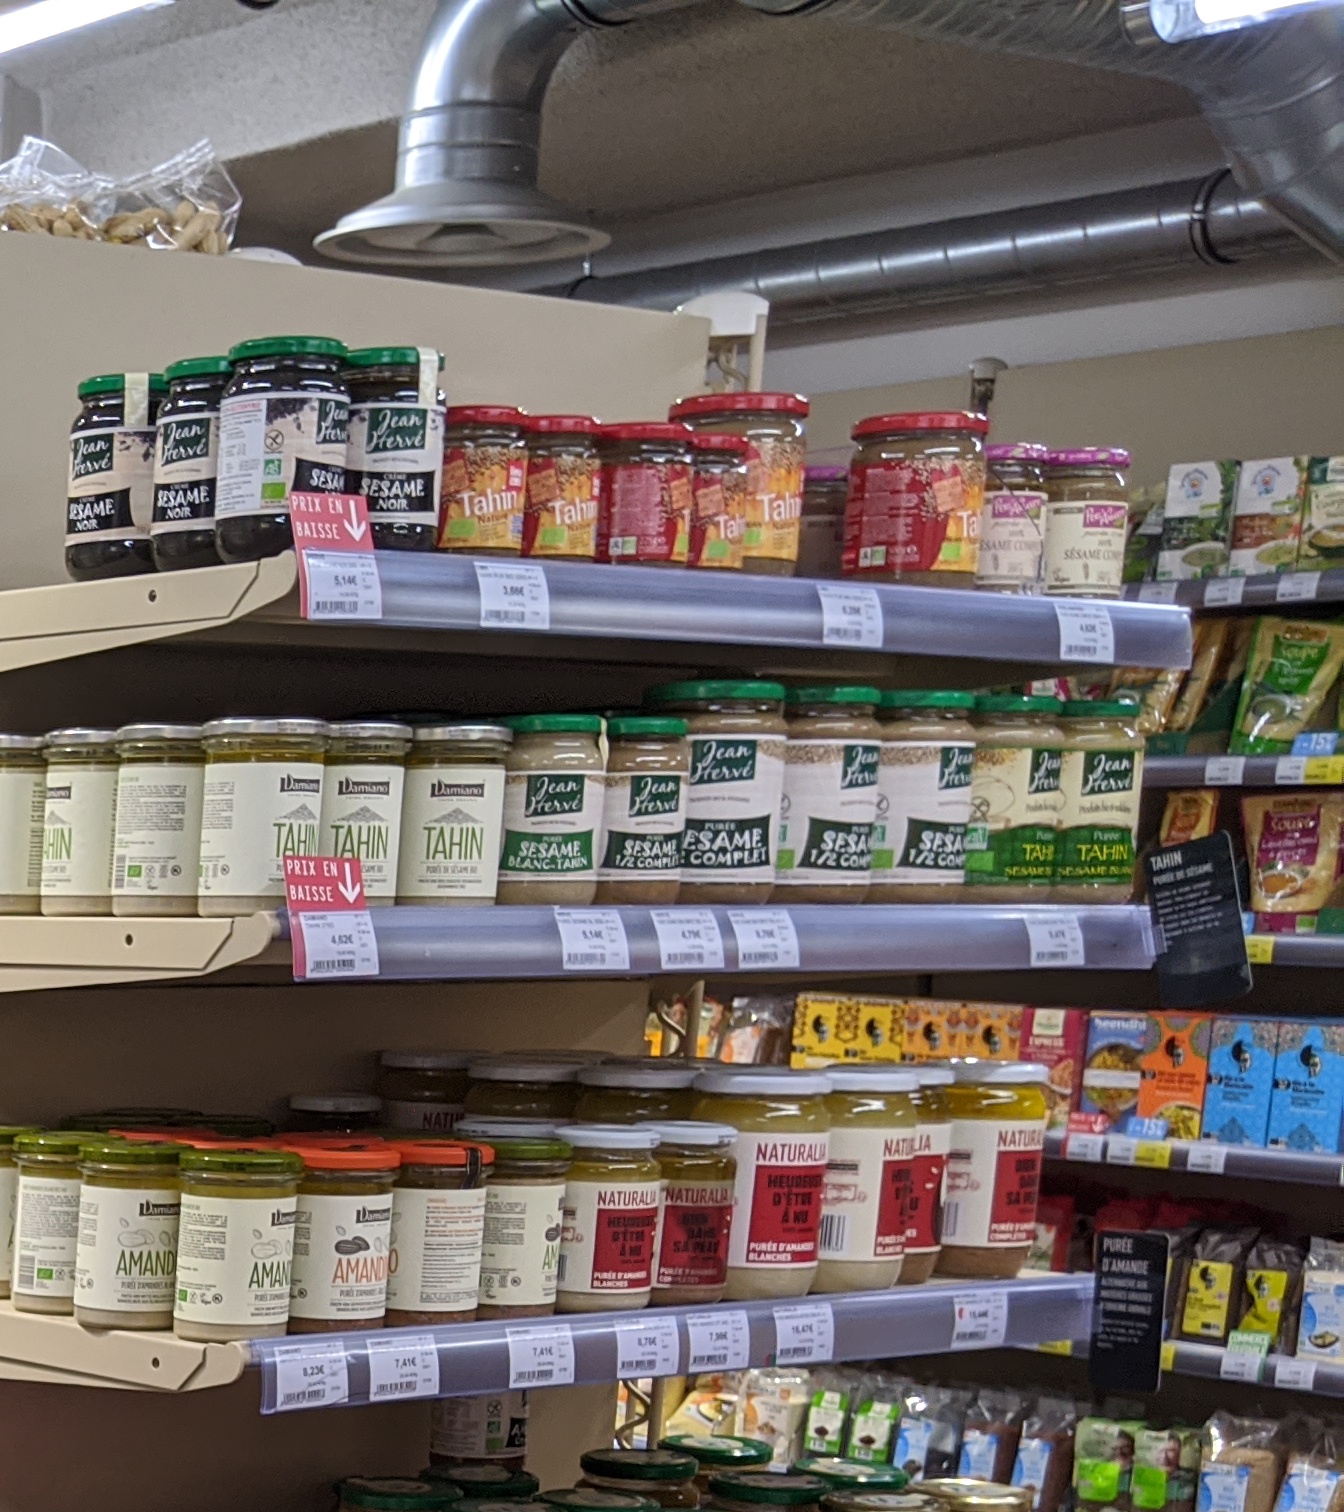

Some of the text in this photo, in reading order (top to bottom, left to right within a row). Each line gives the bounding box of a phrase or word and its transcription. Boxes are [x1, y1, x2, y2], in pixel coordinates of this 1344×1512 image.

[377, 408, 423, 435] Jean
[164, 422, 206, 448] Jean
[367, 429, 424, 451] Hervé
[75, 438, 110, 462] Jean
[161, 438, 207, 466] Hervé
[72, 452, 112, 477] Hervé
[156, 485, 210, 508] SESAME
[360, 478, 426, 497] SESAME
[69, 498, 116, 521] SESAME
[291, 494, 344, 514] PRIX EN
[375, 497, 410, 512] NOIR
[459, 484, 518, 519] Tahin
[164, 507, 192, 520] NOIR
[74, 519, 99, 531] NOIR
[295, 521, 341, 540] BAISSE
[700, 741, 753, 766] Jean
[689, 760, 754, 785] Hervé
[1089, 752, 1133, 779] Jean
[343, 775, 389, 795] Damiano
[434, 778, 485, 797] Damiano
[532, 776, 582, 802] Jean
[637, 776, 679, 802] Jean
[1081, 772, 1134, 796] Hervé
[524, 798, 584, 818] Hervé
[629, 796, 681, 817] Hervé
[330, 824, 389, 859] TAHIN
[423, 826, 485, 861] TAHIN
[518, 840, 582, 858] SESAME
[821, 831, 871, 855] SESA
[919, 831, 965, 855] SESA
[1076, 843, 1129, 862] TAHIN
[615, 855, 636, 868] 1/2
[689, 849, 768, 867] COMPLET
[1021, 844, 1055, 862] TAHI
[1149, 850, 1183, 873] TAHIN
[286, 858, 339, 878] PRIX EN
[289, 885, 334, 902] BAISSE
[996, 1129, 1044, 1149] NATURA
[748, 1251, 793, 1262] BLANCHES
[749, 1240, 777, 1251] PURÉE
[248, 1261, 291, 1289] AMAN
